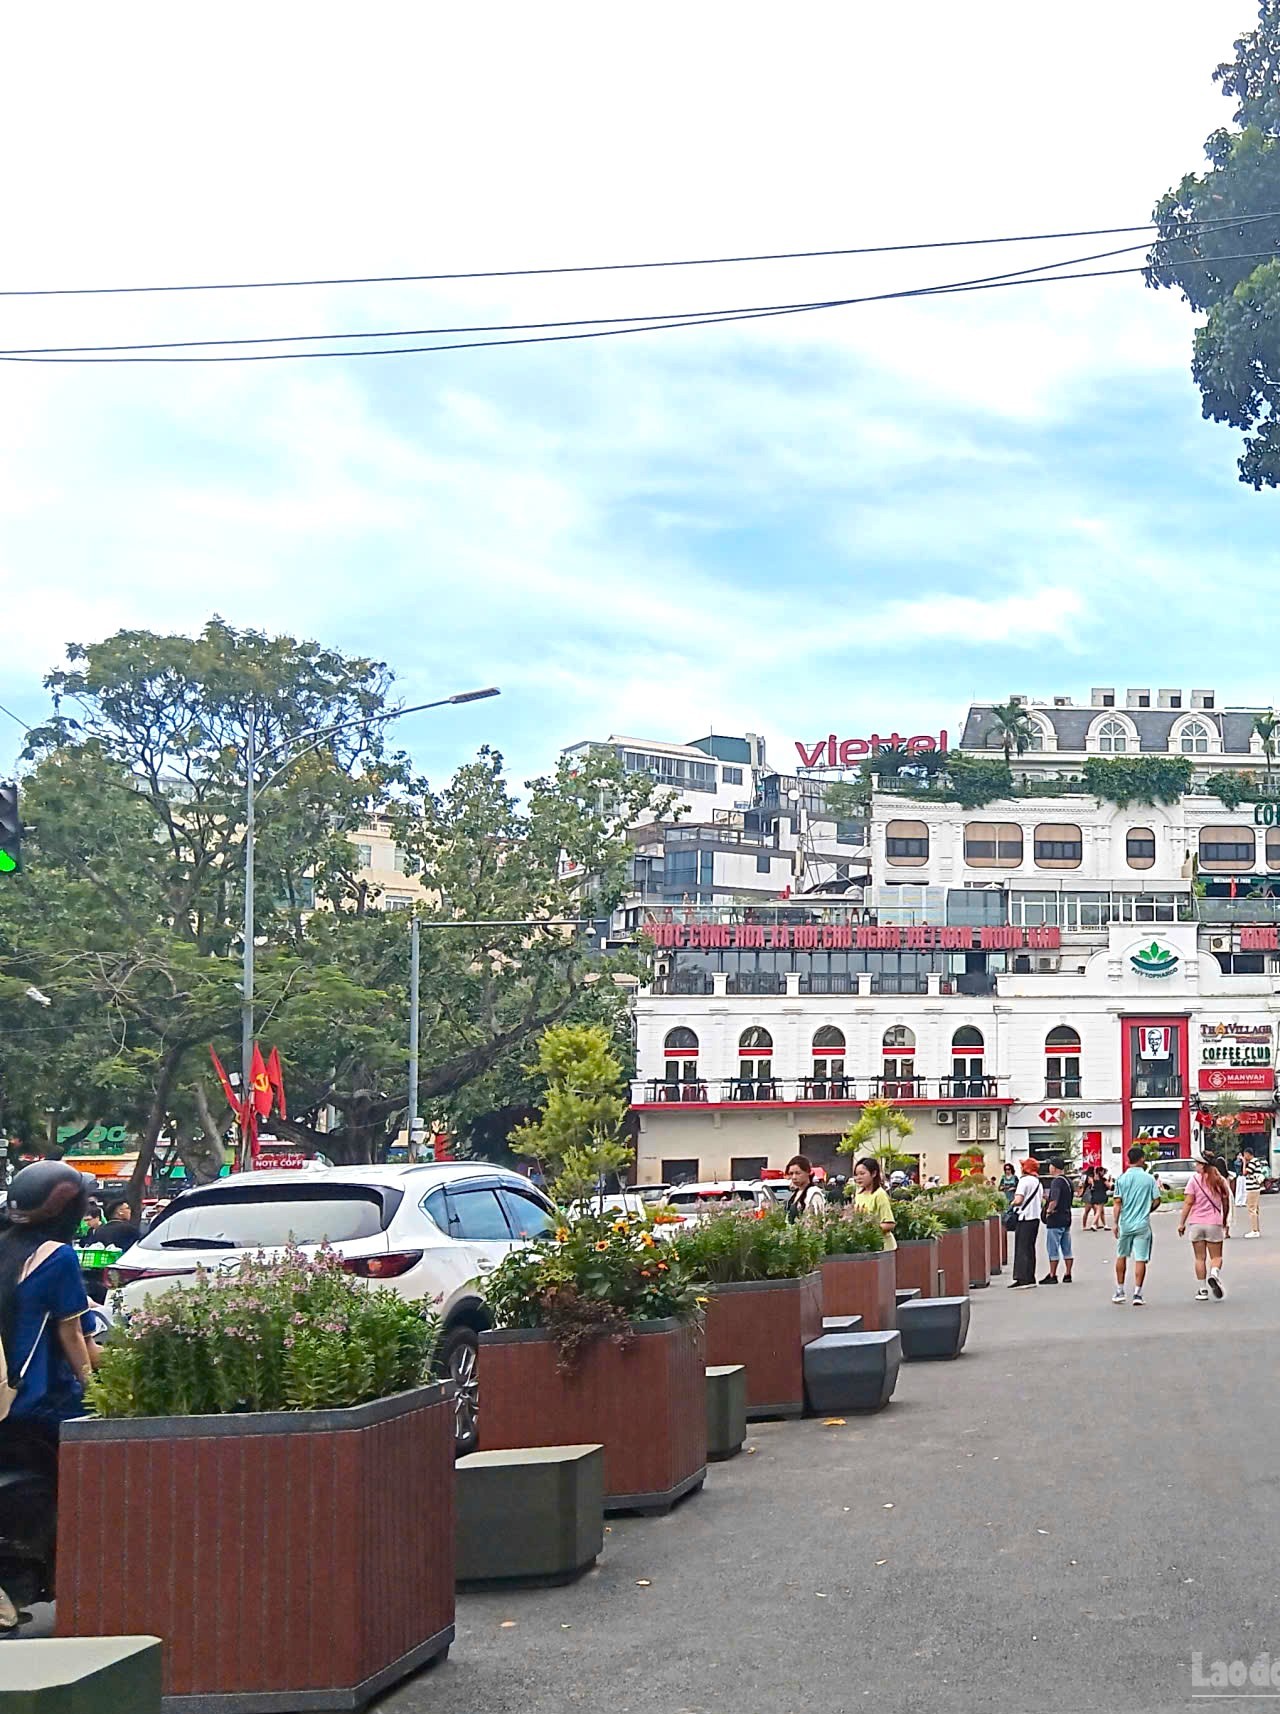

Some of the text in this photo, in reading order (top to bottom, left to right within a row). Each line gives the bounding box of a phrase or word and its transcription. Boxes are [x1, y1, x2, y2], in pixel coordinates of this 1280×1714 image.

[795, 730, 948, 768] viettel
[1203, 1047, 1271, 1060] COFFEE CLUB
[1138, 1125, 1176, 1139] KFC
[255, 1160, 280, 1168] NOTE
